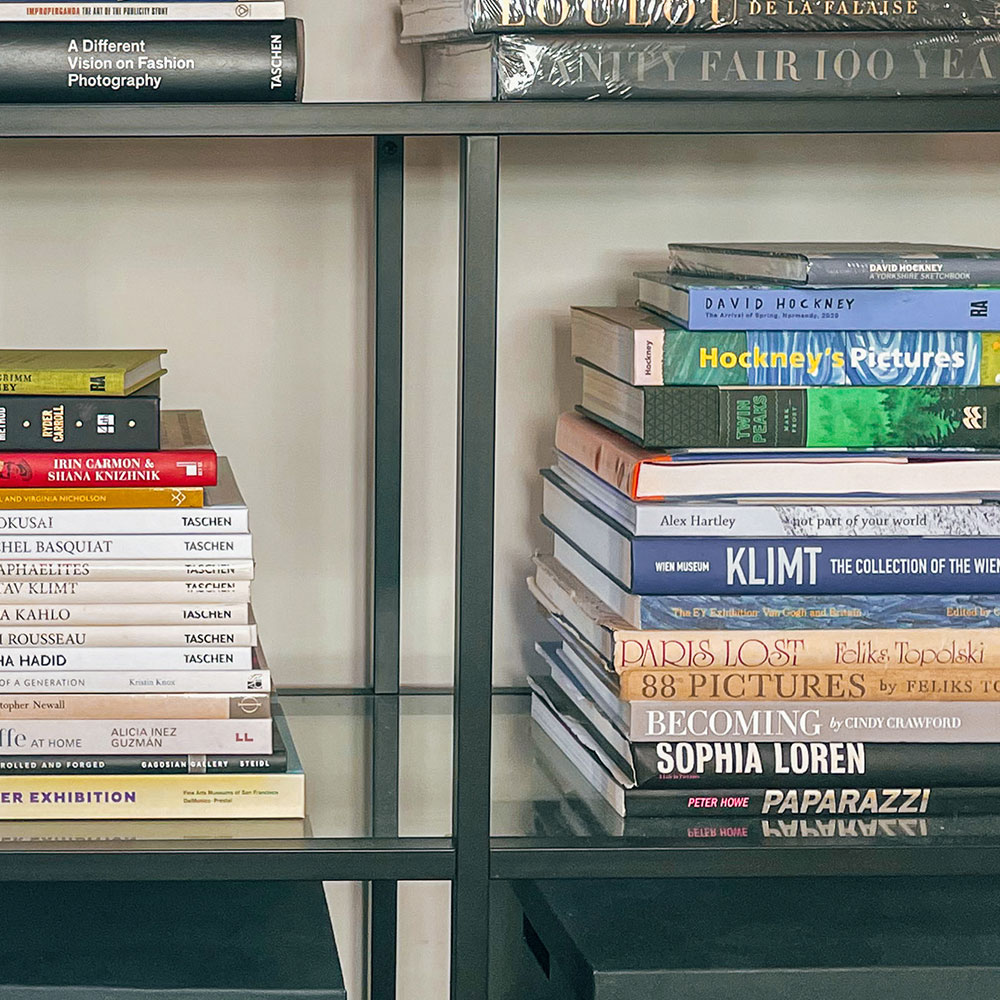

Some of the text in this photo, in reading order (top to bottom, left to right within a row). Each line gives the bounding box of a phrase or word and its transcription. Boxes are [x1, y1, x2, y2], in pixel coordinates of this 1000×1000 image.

[83, 39, 146, 53] Different
[67, 56, 195, 70] Vision on Fashion
[270, 34, 282, 89] TASCHEN
[700, 48, 801, 81] FAIR
[67, 73, 162, 89] Photography
[899, 263, 943, 272] HOCKNEY
[705, 297, 855, 310] DAVID HOCKNEY
[644, 339, 653, 376] Hockney
[699, 346, 965, 374] Hockney's Pictures
[752, 395, 768, 444] PEAKS
[85, 458, 142, 469] CARMON
[181, 516, 232, 527] TASCHEN
[660, 514, 927, 529] Alex Hartley world
[35, 540, 113, 555] BASQUIAT
[726, 546, 928, 586] KLIMT COLLECTION
[28, 581, 78, 595] KLIMT
[15, 608, 70, 621] KAHLO
[7, 632, 86, 646] ROUSSEAU
[621, 638, 985, 667] PARIS LOST Topolski
[19, 654, 67, 667] HADID
[22, 678, 85, 687] GENERATION
[641, 673, 972, 698] 88 PICTURES FELIKS
[33, 699, 65, 711] Newall
[645, 709, 962, 736] BECOMING CINDY CRAWFORD
[110, 727, 177, 738] ALICIA INEZ
[656, 742, 866, 775] SOPHIA LOREN
[29, 791, 137, 803] EXHIBITION
[687, 788, 931, 814] PETER HOWE PAPARAZZI
